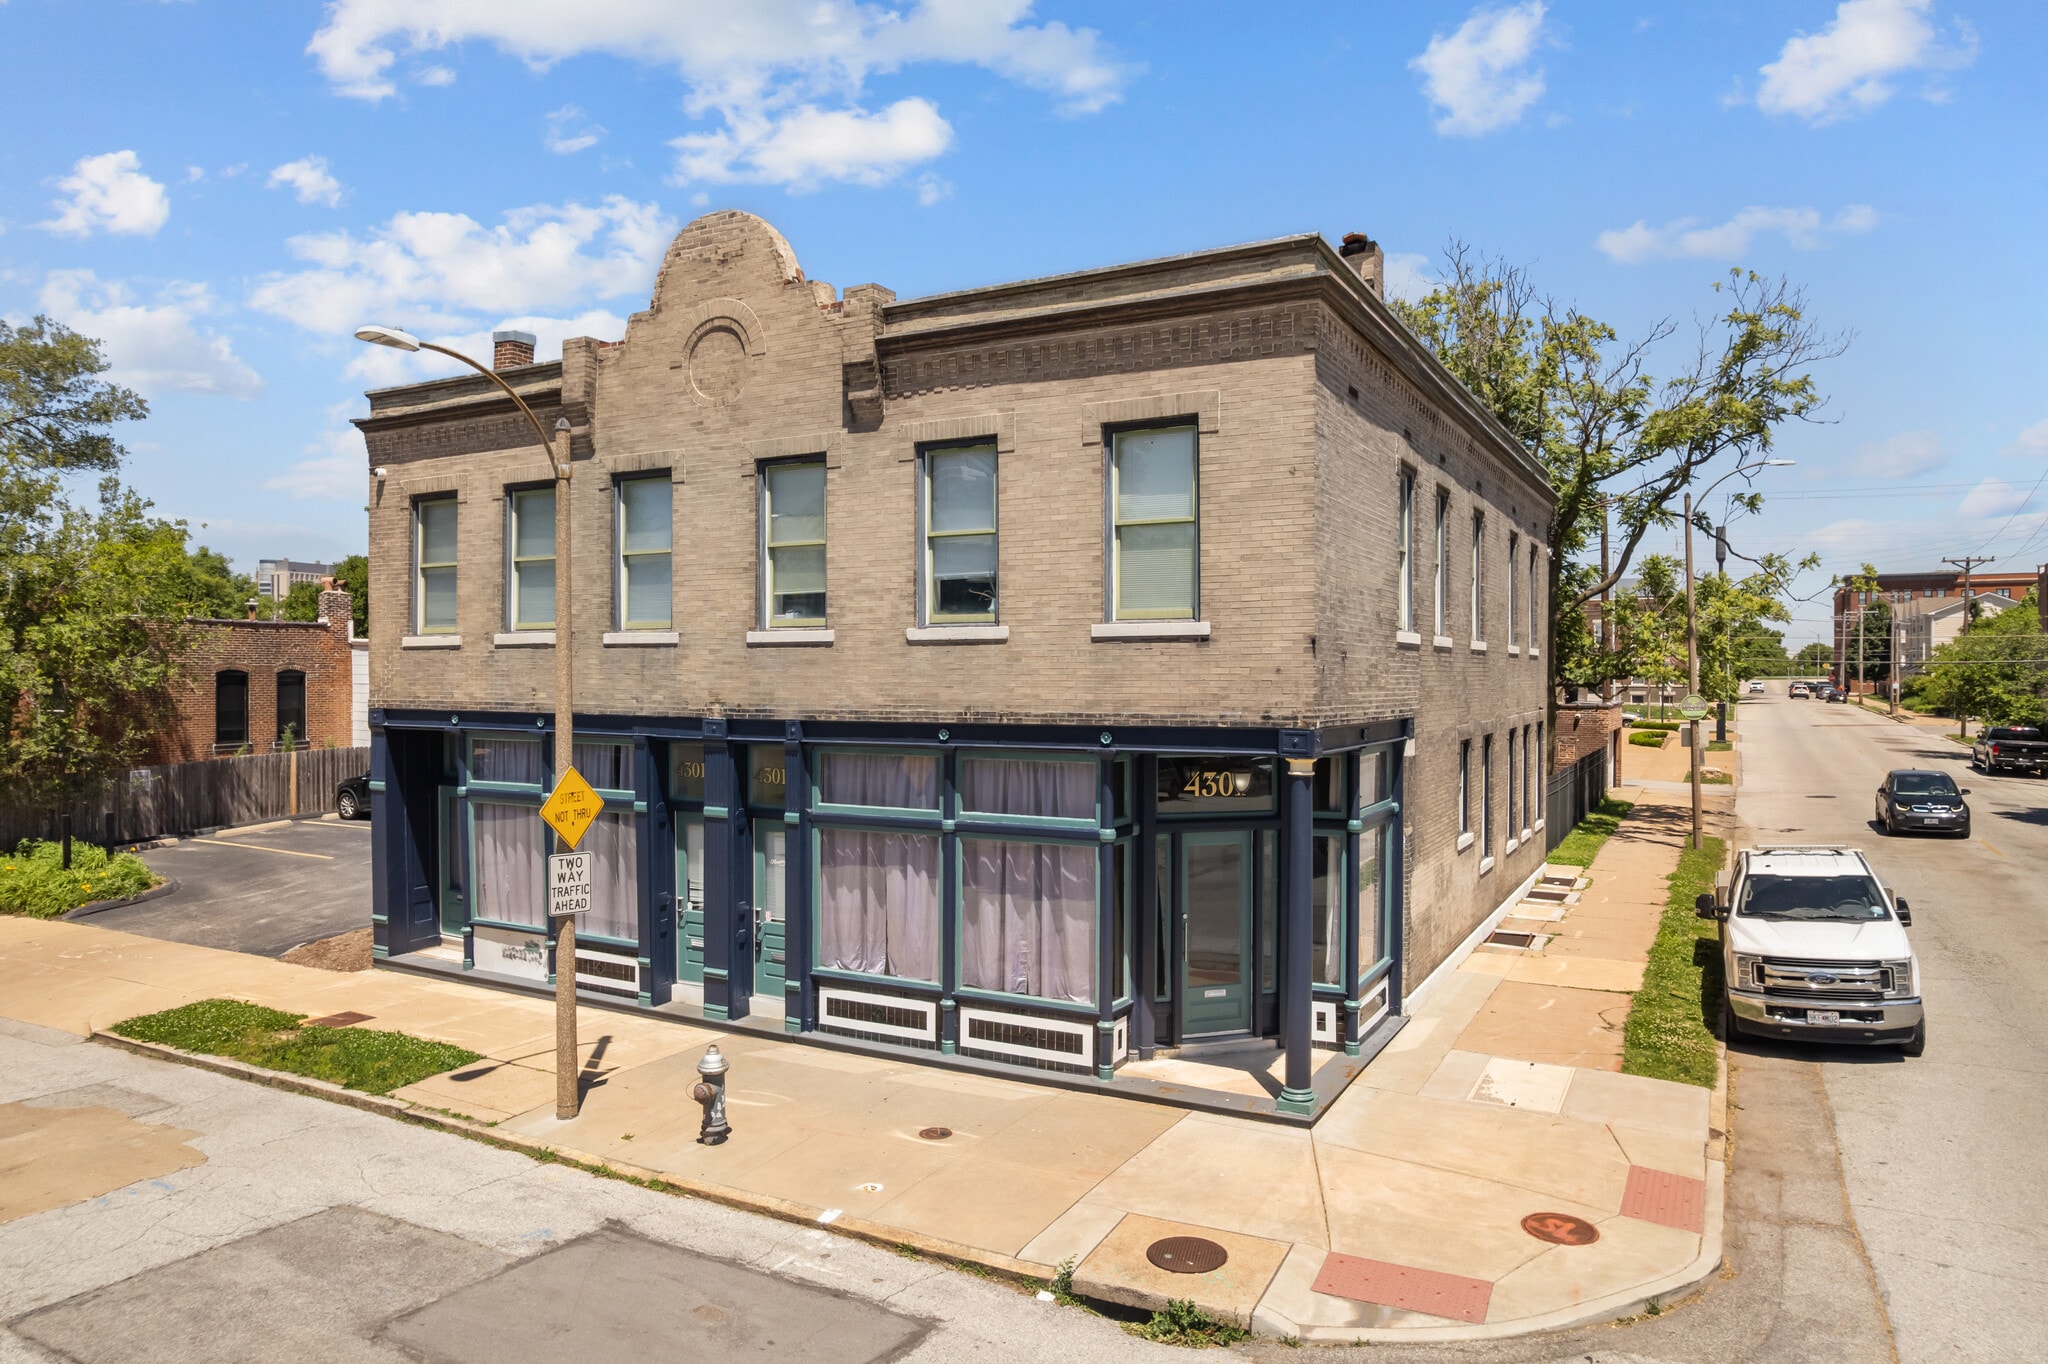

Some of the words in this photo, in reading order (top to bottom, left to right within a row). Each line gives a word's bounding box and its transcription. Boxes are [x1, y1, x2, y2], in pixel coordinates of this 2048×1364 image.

[1184, 771, 1246, 797] 430
[560, 791, 585, 804] STREET
[555, 810, 568, 823] NOT
[573, 808, 591, 820] THRU
[558, 857, 583, 869] TWO
[557, 870, 584, 883] WAY
[551, 883, 590, 898] TRAFFIC
[554, 898, 587, 912] AHEAD
